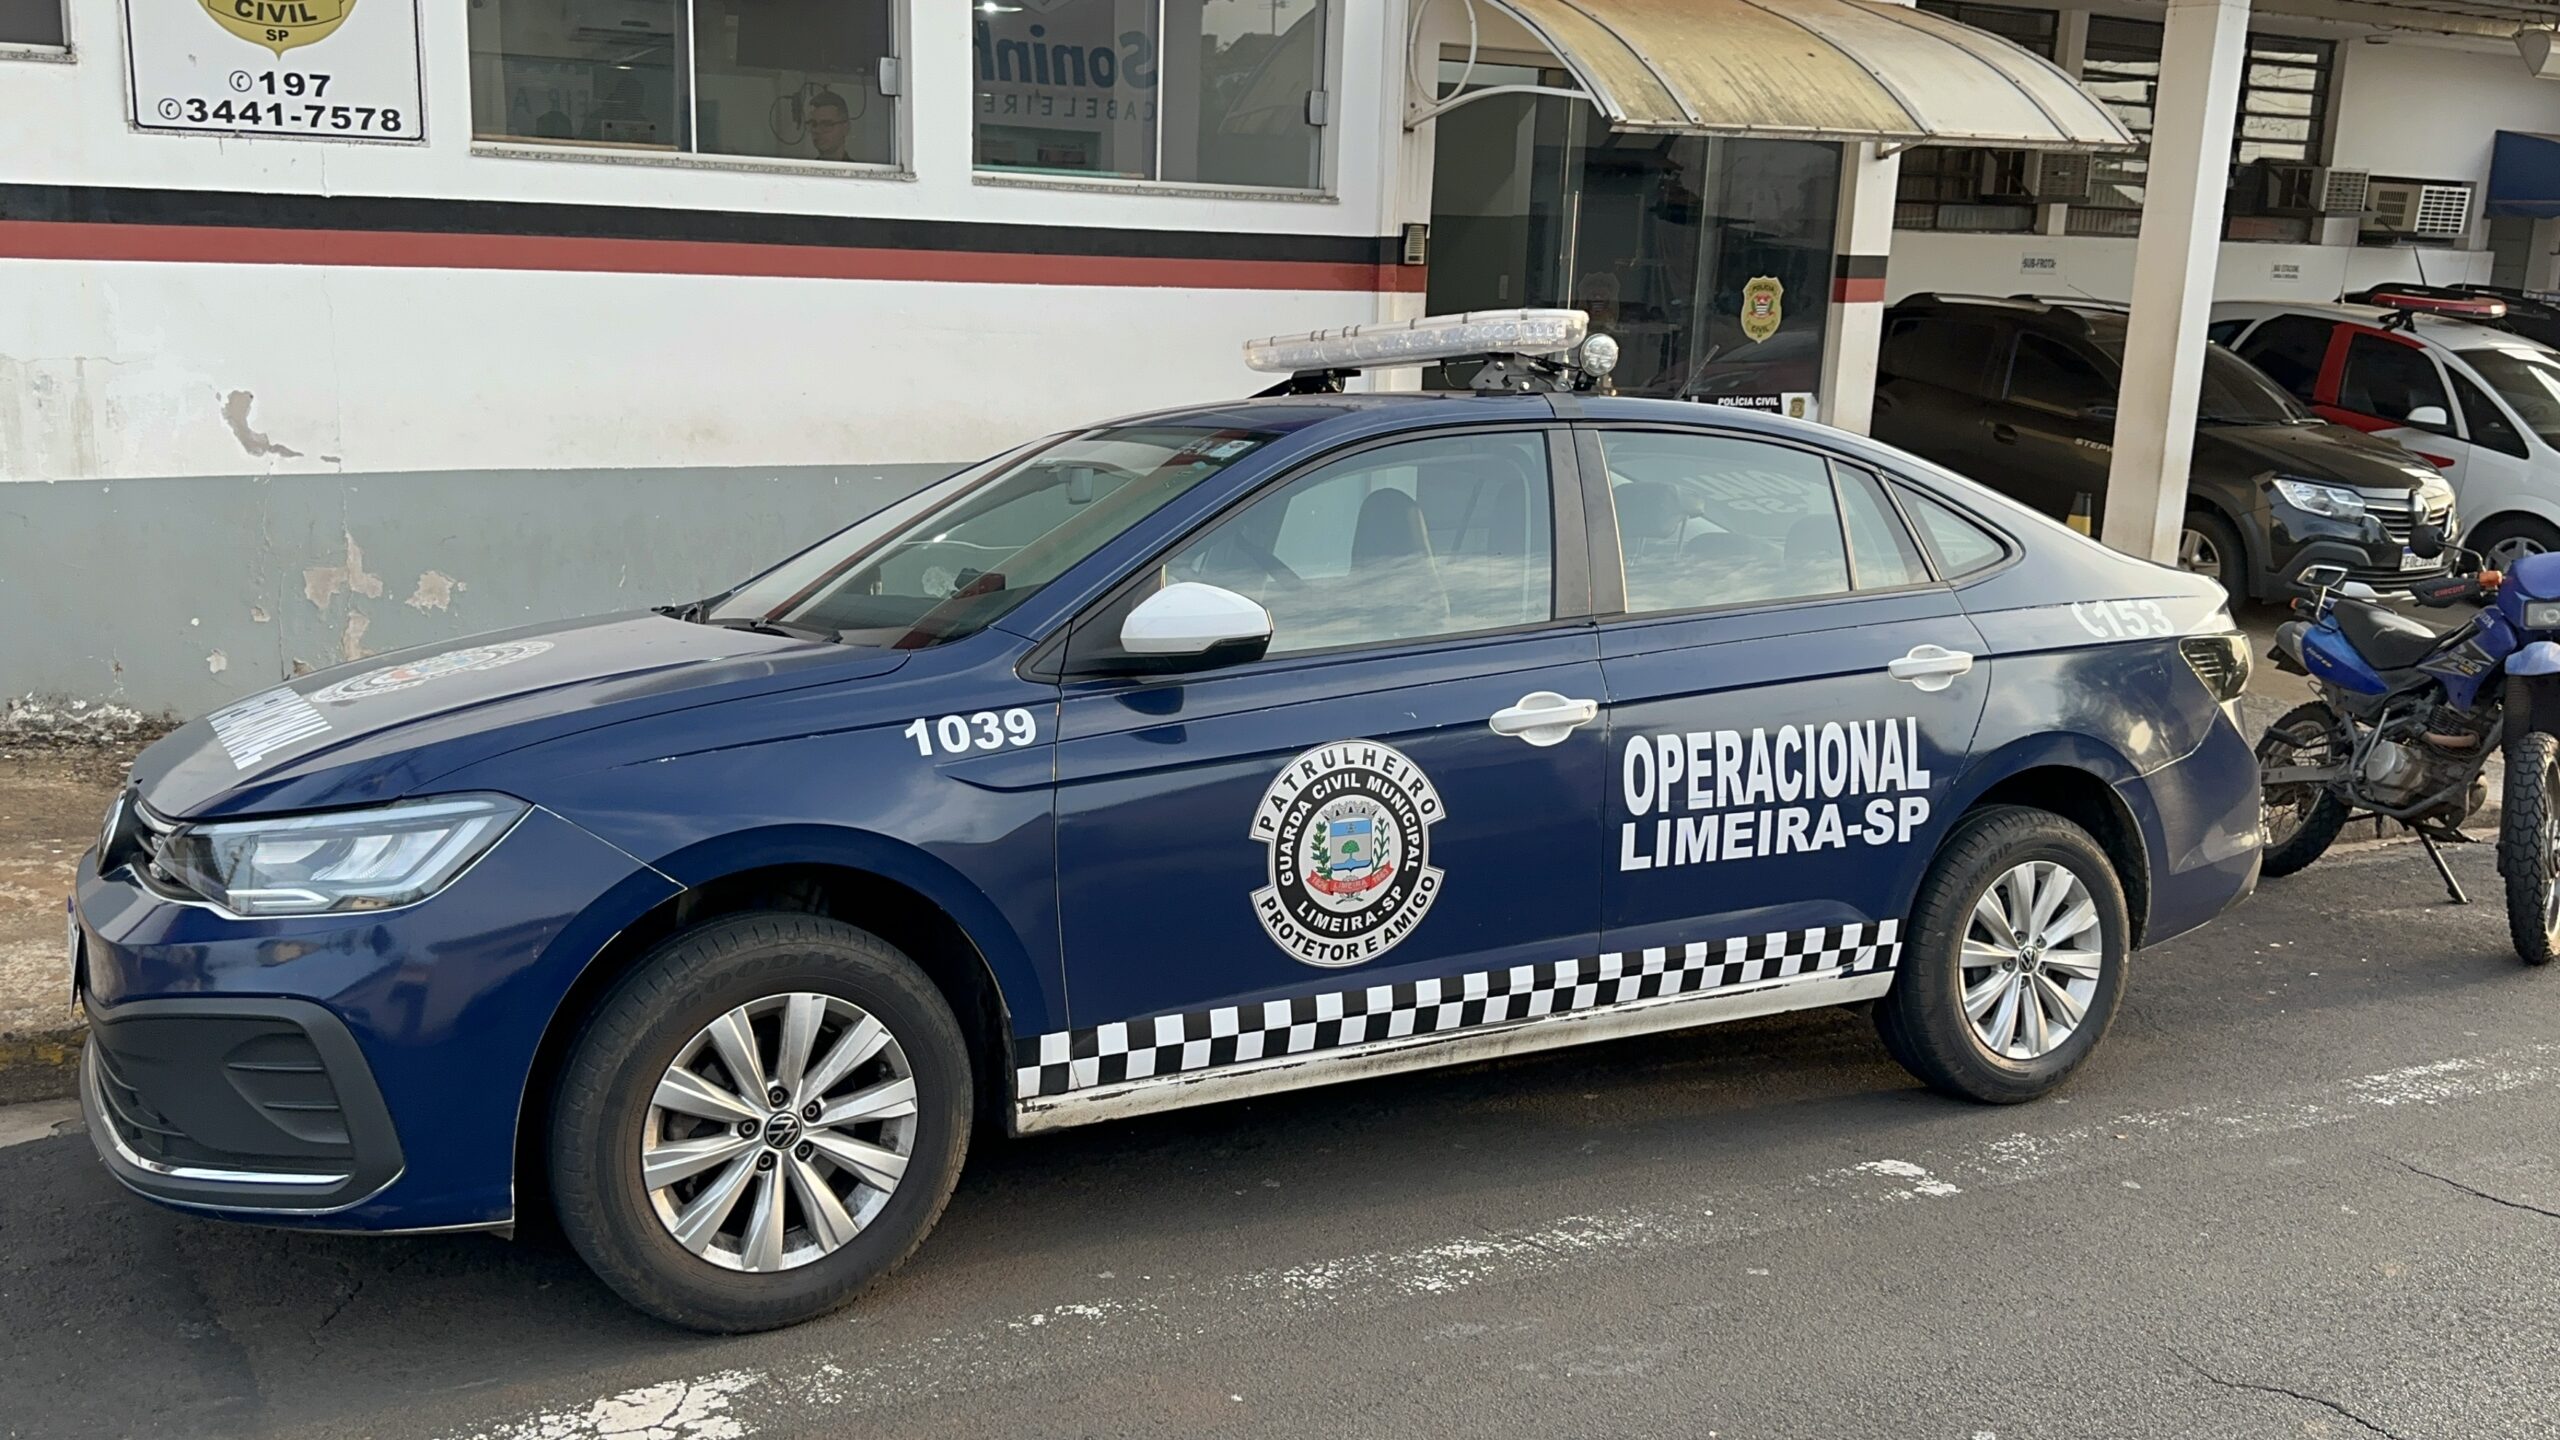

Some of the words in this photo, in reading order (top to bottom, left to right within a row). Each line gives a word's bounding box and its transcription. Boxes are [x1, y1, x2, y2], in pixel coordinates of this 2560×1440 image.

[234, 0, 317, 24] CIVIL
[265, 29, 289, 41] SP
[258, 71, 331, 98] 197
[185, 98, 402, 133] 3441-7578
[1755, 397, 1779, 406] CIVIL
[904, 707, 1037, 756] 1039
[1259, 747, 1436, 833] PATRULHEIRO
[1623, 716, 1931, 817] OPERACIONAL
[1279, 799, 1313, 887] GUARDA
[1311, 773, 1362, 800] CIVIL
[1366, 775, 1420, 872] MUNICIPAL
[1620, 796, 1930, 872] LIMEIRA-SP
[1260, 896, 1360, 961] PROTETOR
[1364, 936, 1379, 954] E
[1384, 876, 1436, 945] AMIGO
[1296, 885, 1404, 933] LIMEIRA-SP
